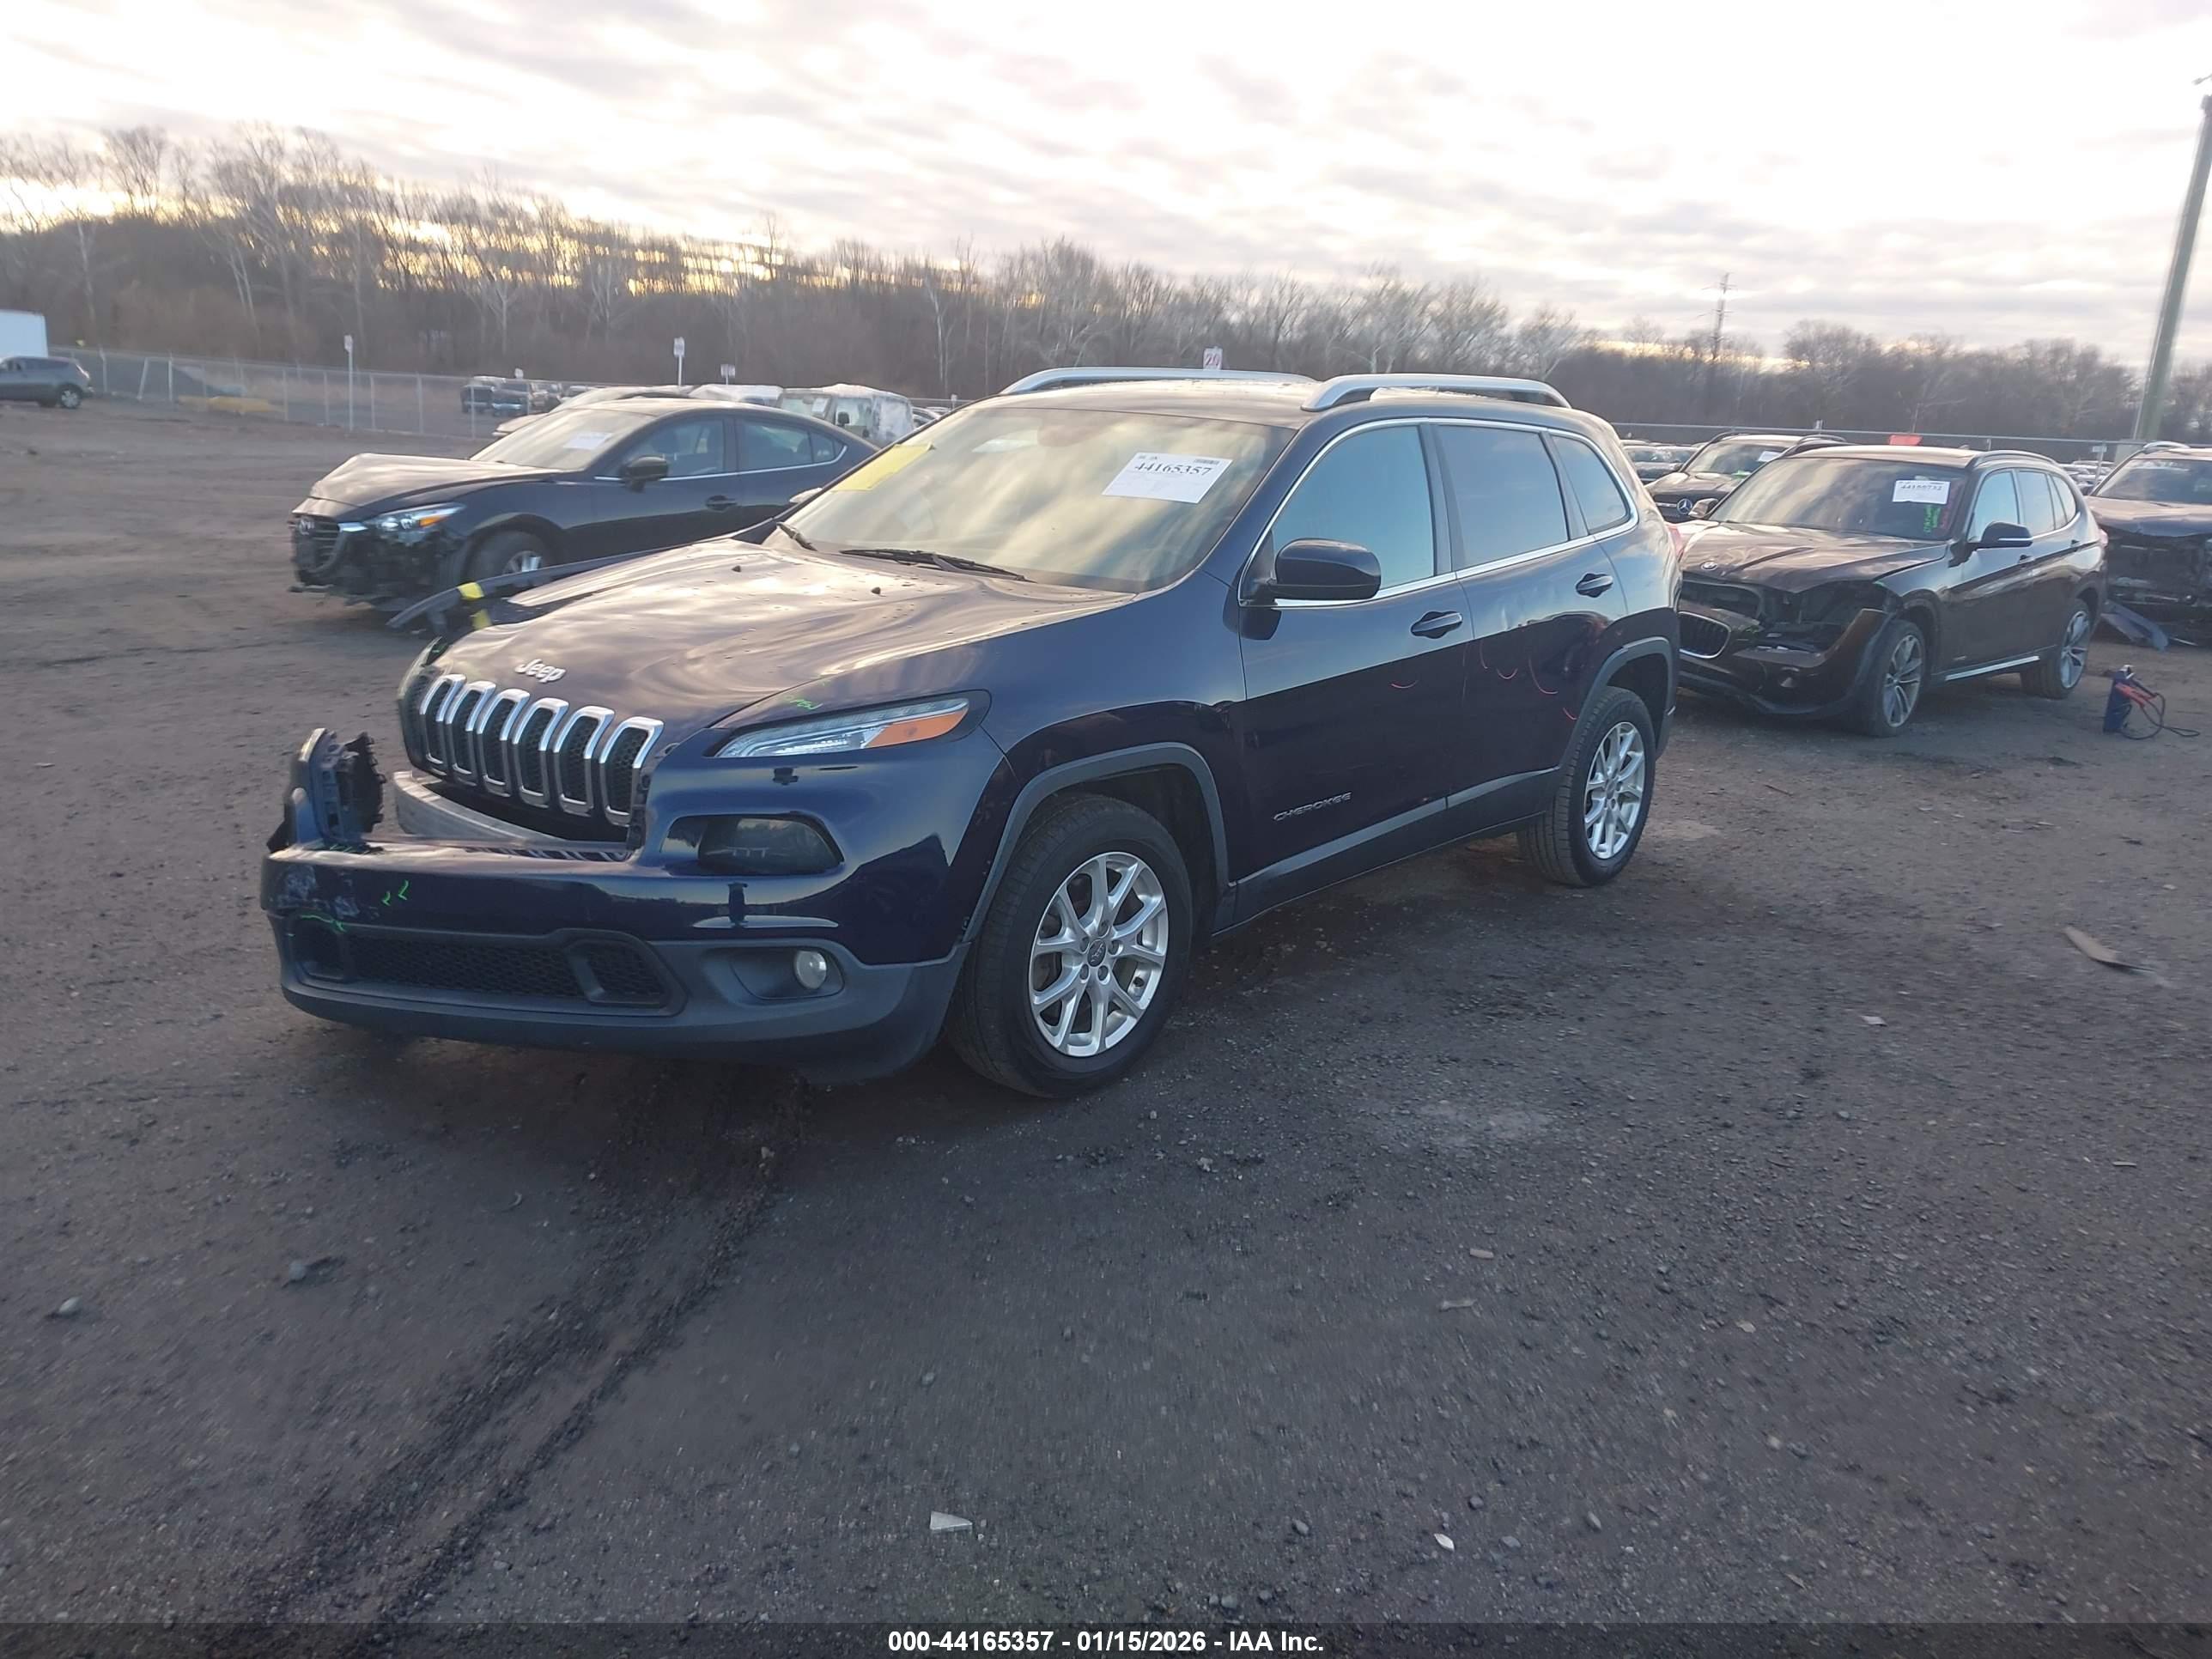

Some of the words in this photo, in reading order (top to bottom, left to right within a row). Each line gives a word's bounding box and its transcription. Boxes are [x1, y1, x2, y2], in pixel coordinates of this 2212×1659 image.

[1134, 461, 1212, 476] 44165357
[514, 658, 567, 684] Jeep
[1273, 792, 1352, 820] CHEROKEE
